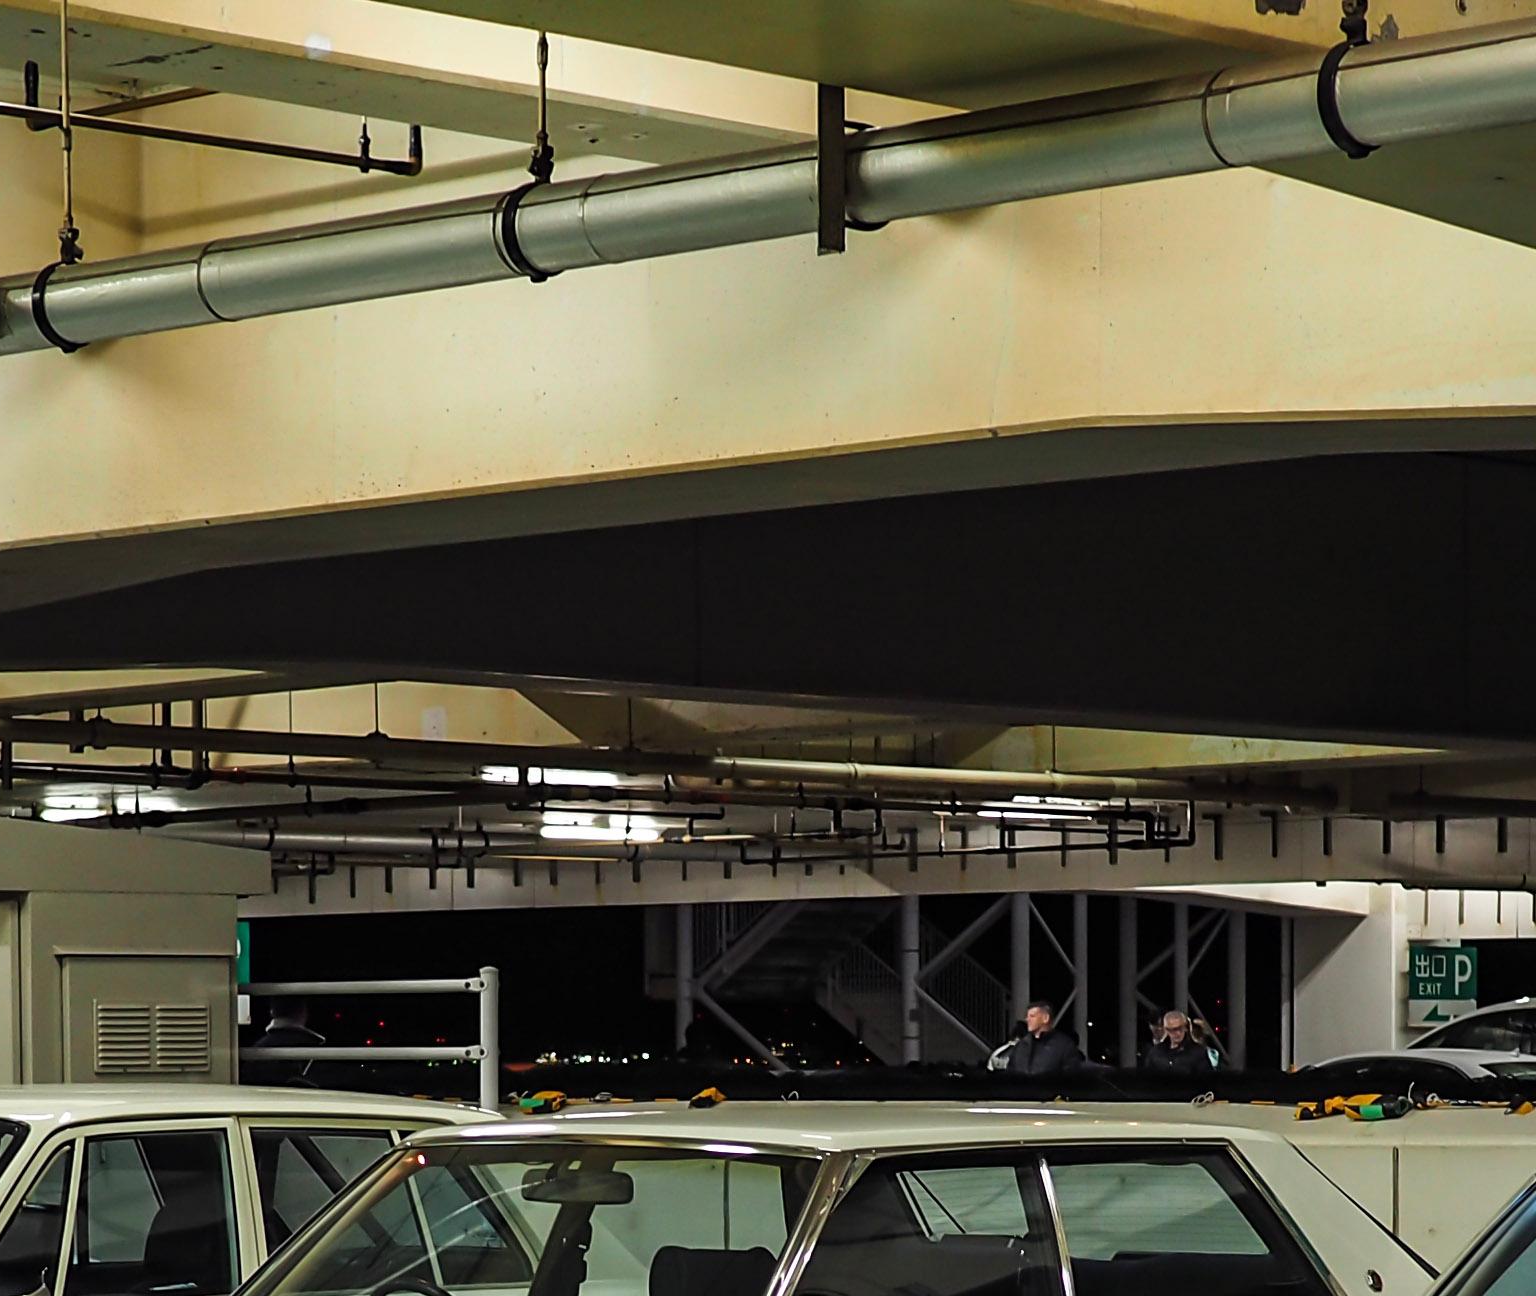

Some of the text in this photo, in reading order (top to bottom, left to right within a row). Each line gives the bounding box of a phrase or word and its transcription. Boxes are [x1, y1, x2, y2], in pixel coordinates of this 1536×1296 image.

[1415, 954, 1446, 978] 出口
[1454, 954, 1472, 996] P
[1419, 982, 1442, 996] EXIT
